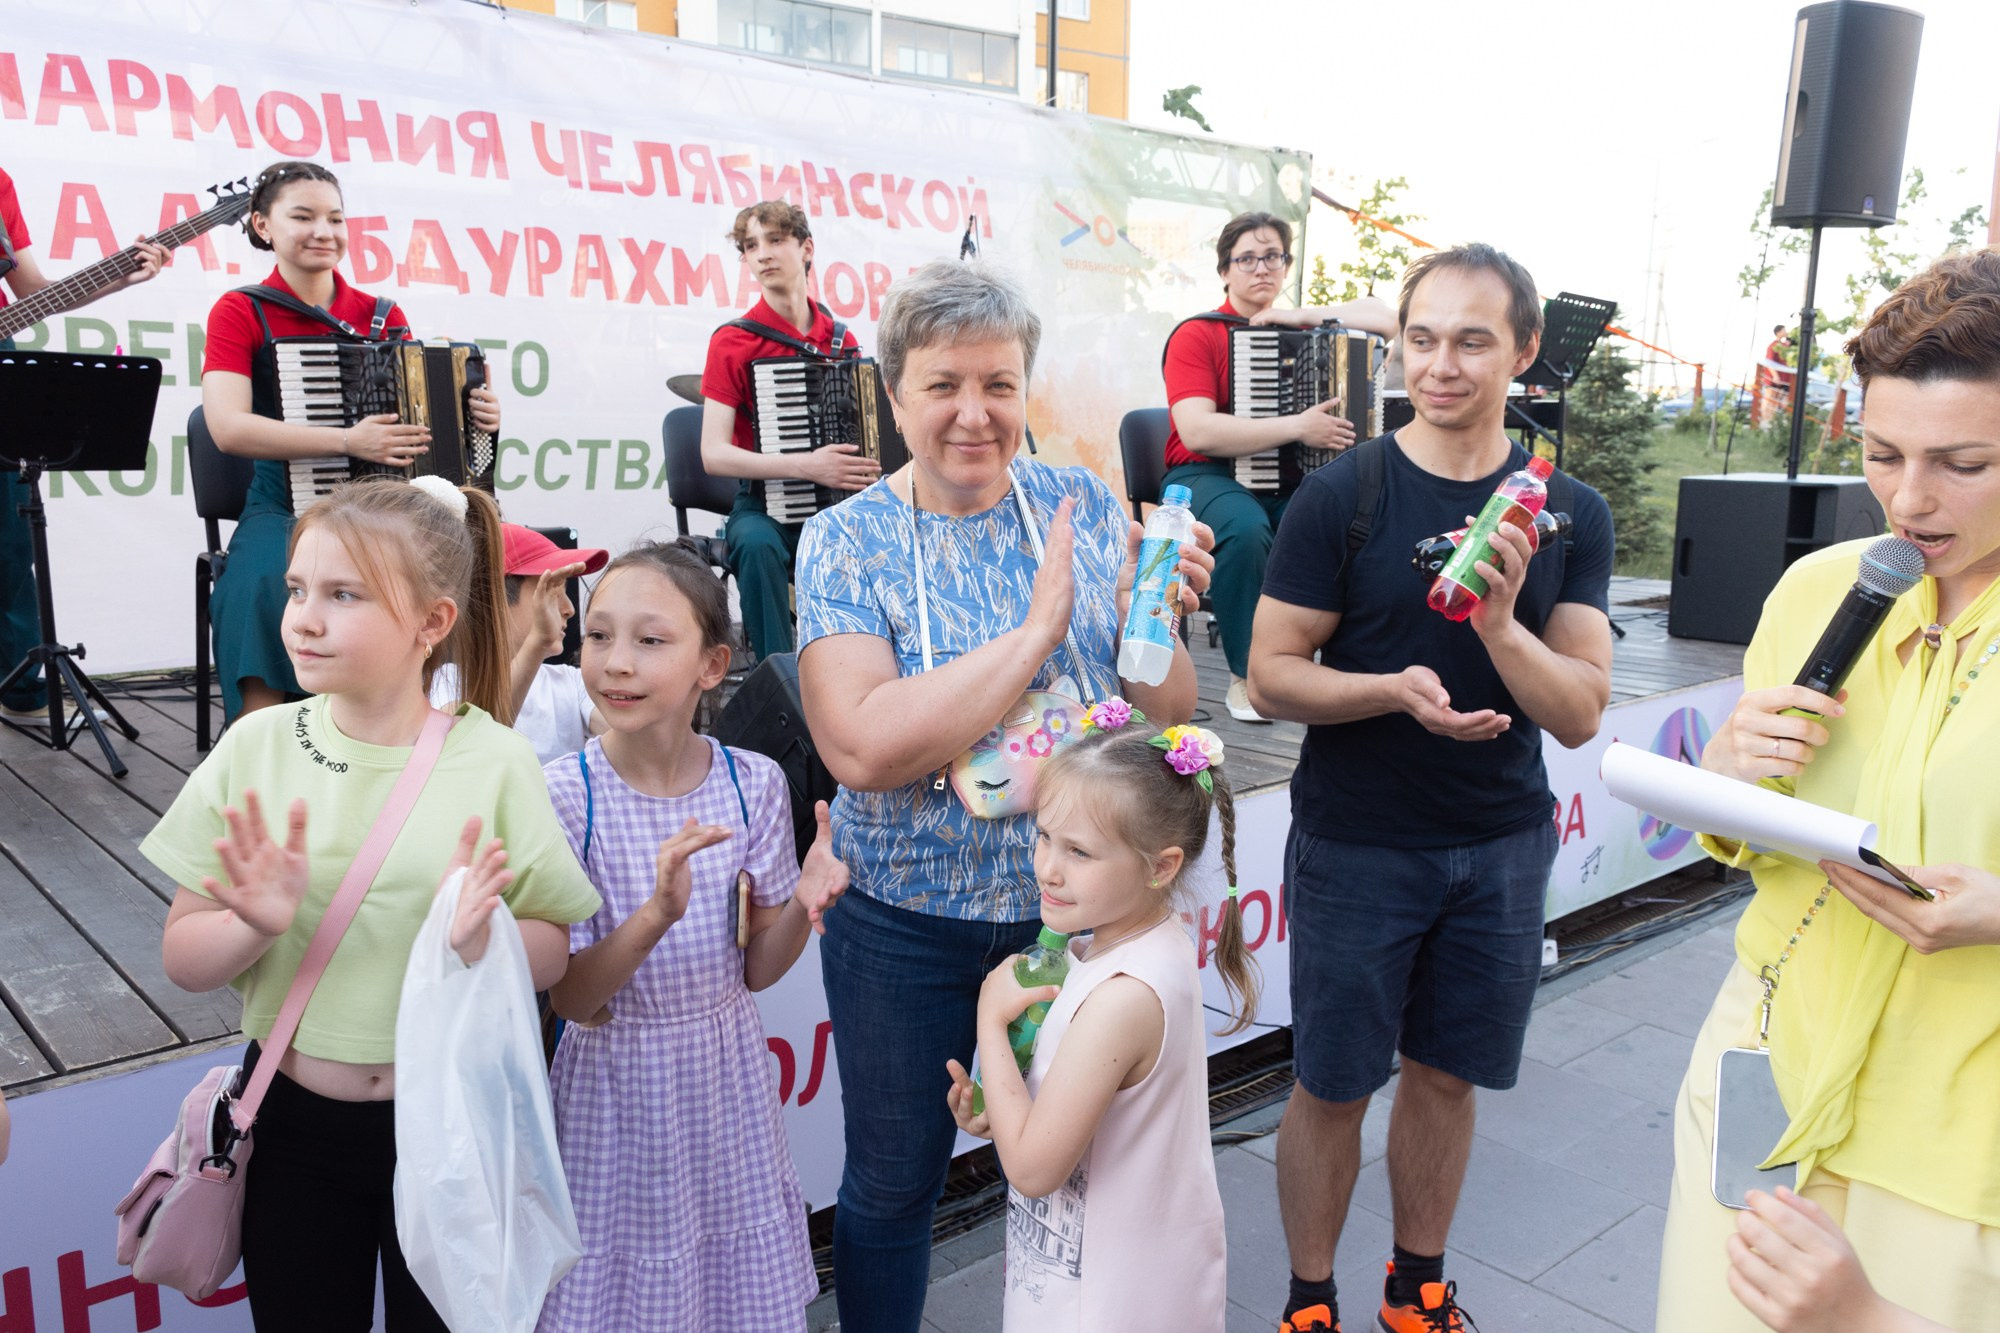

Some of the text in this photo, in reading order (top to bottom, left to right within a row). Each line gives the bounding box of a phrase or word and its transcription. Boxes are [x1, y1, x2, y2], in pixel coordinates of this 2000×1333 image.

[530, 121, 993, 239] ЧЕЛЯБИНСКОЙ
[295, 706, 348, 773] ALWAYS IN THE MOOD
